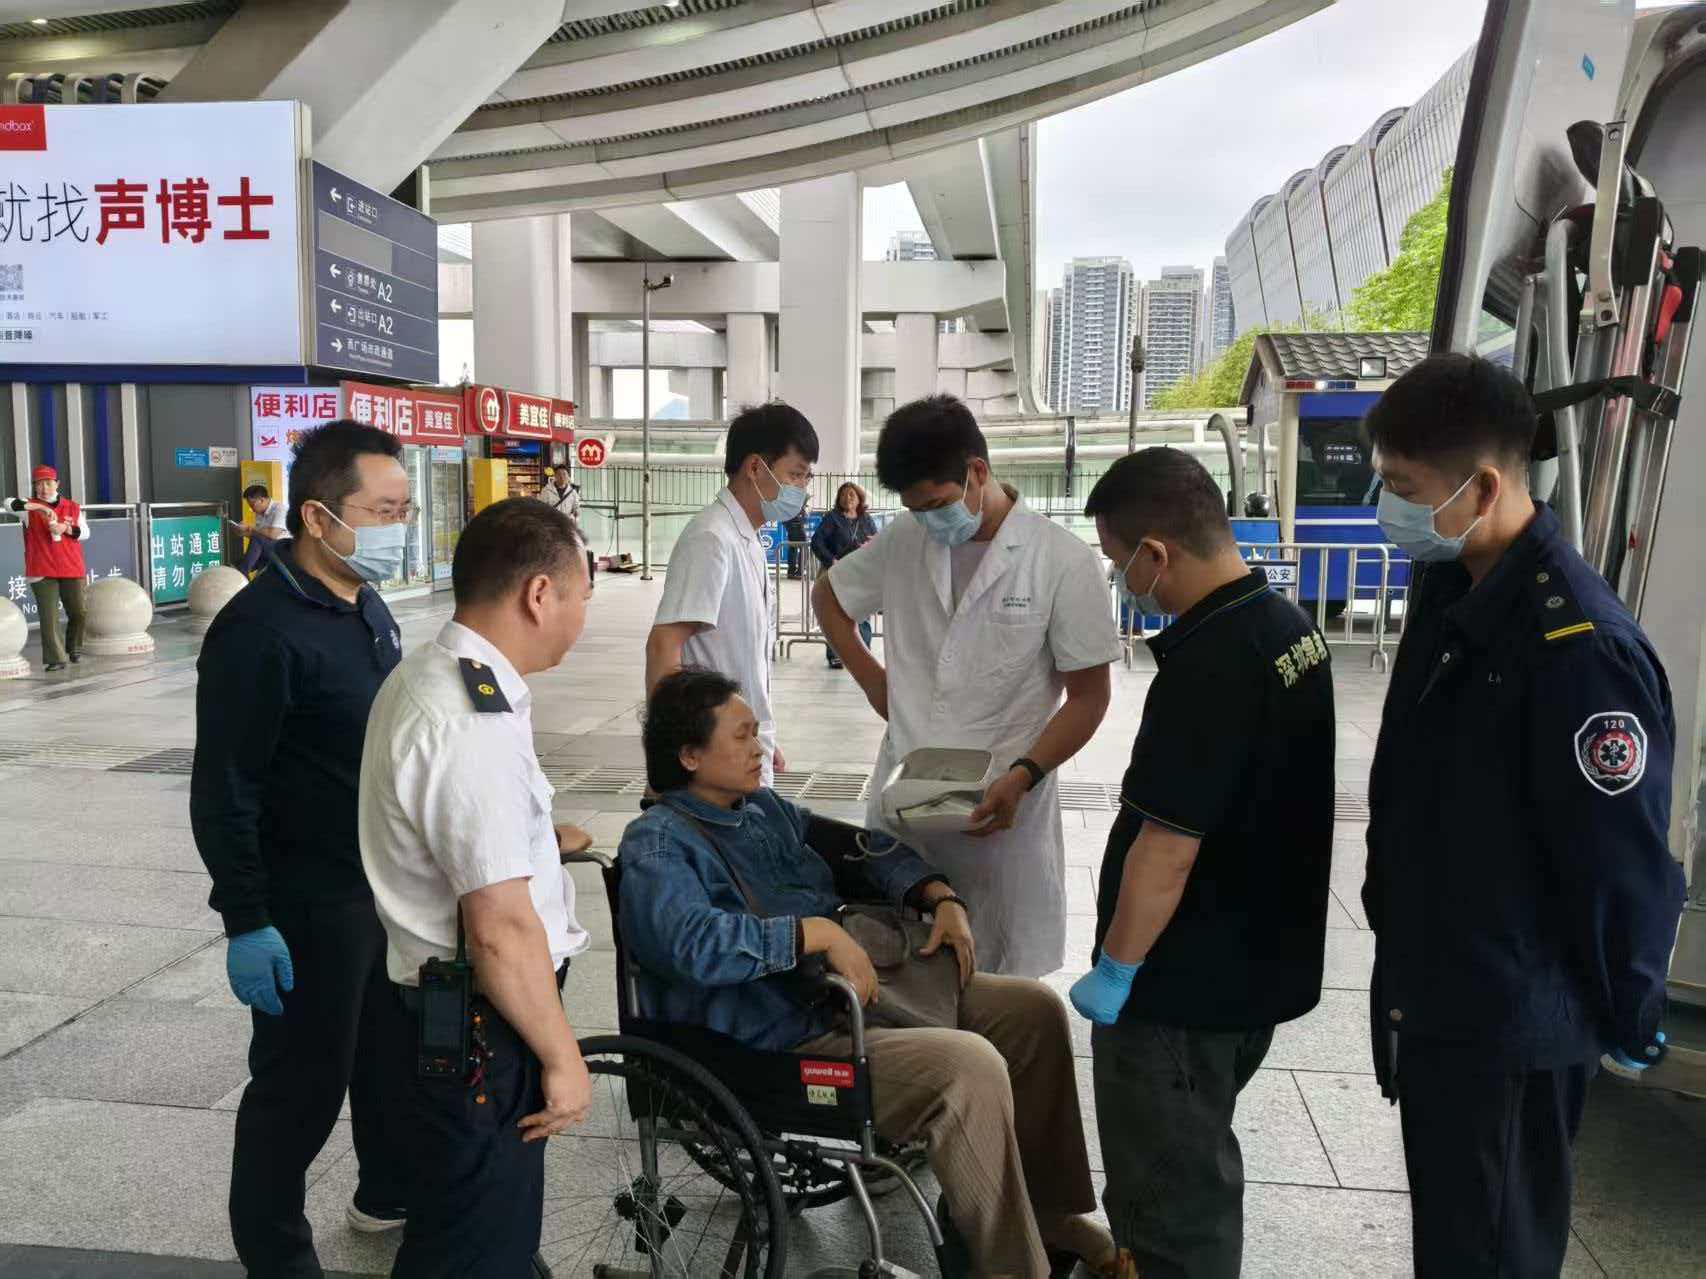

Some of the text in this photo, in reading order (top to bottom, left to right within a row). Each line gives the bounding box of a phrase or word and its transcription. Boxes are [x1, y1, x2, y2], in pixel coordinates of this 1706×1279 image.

[0, 176, 274, 246] 就找声博士
[377, 281, 393, 304] A2
[378, 313, 393, 336] A2
[254, 393, 337, 419] 便利店
[351, 391, 454, 437] 便利店 美宜佳
[519, 403, 575, 430] 美宜佳 便利店
[153, 531, 220, 560] 出站通道
[1267, 568, 1291, 580] 公安
[1603, 719, 1625, 730] 120
